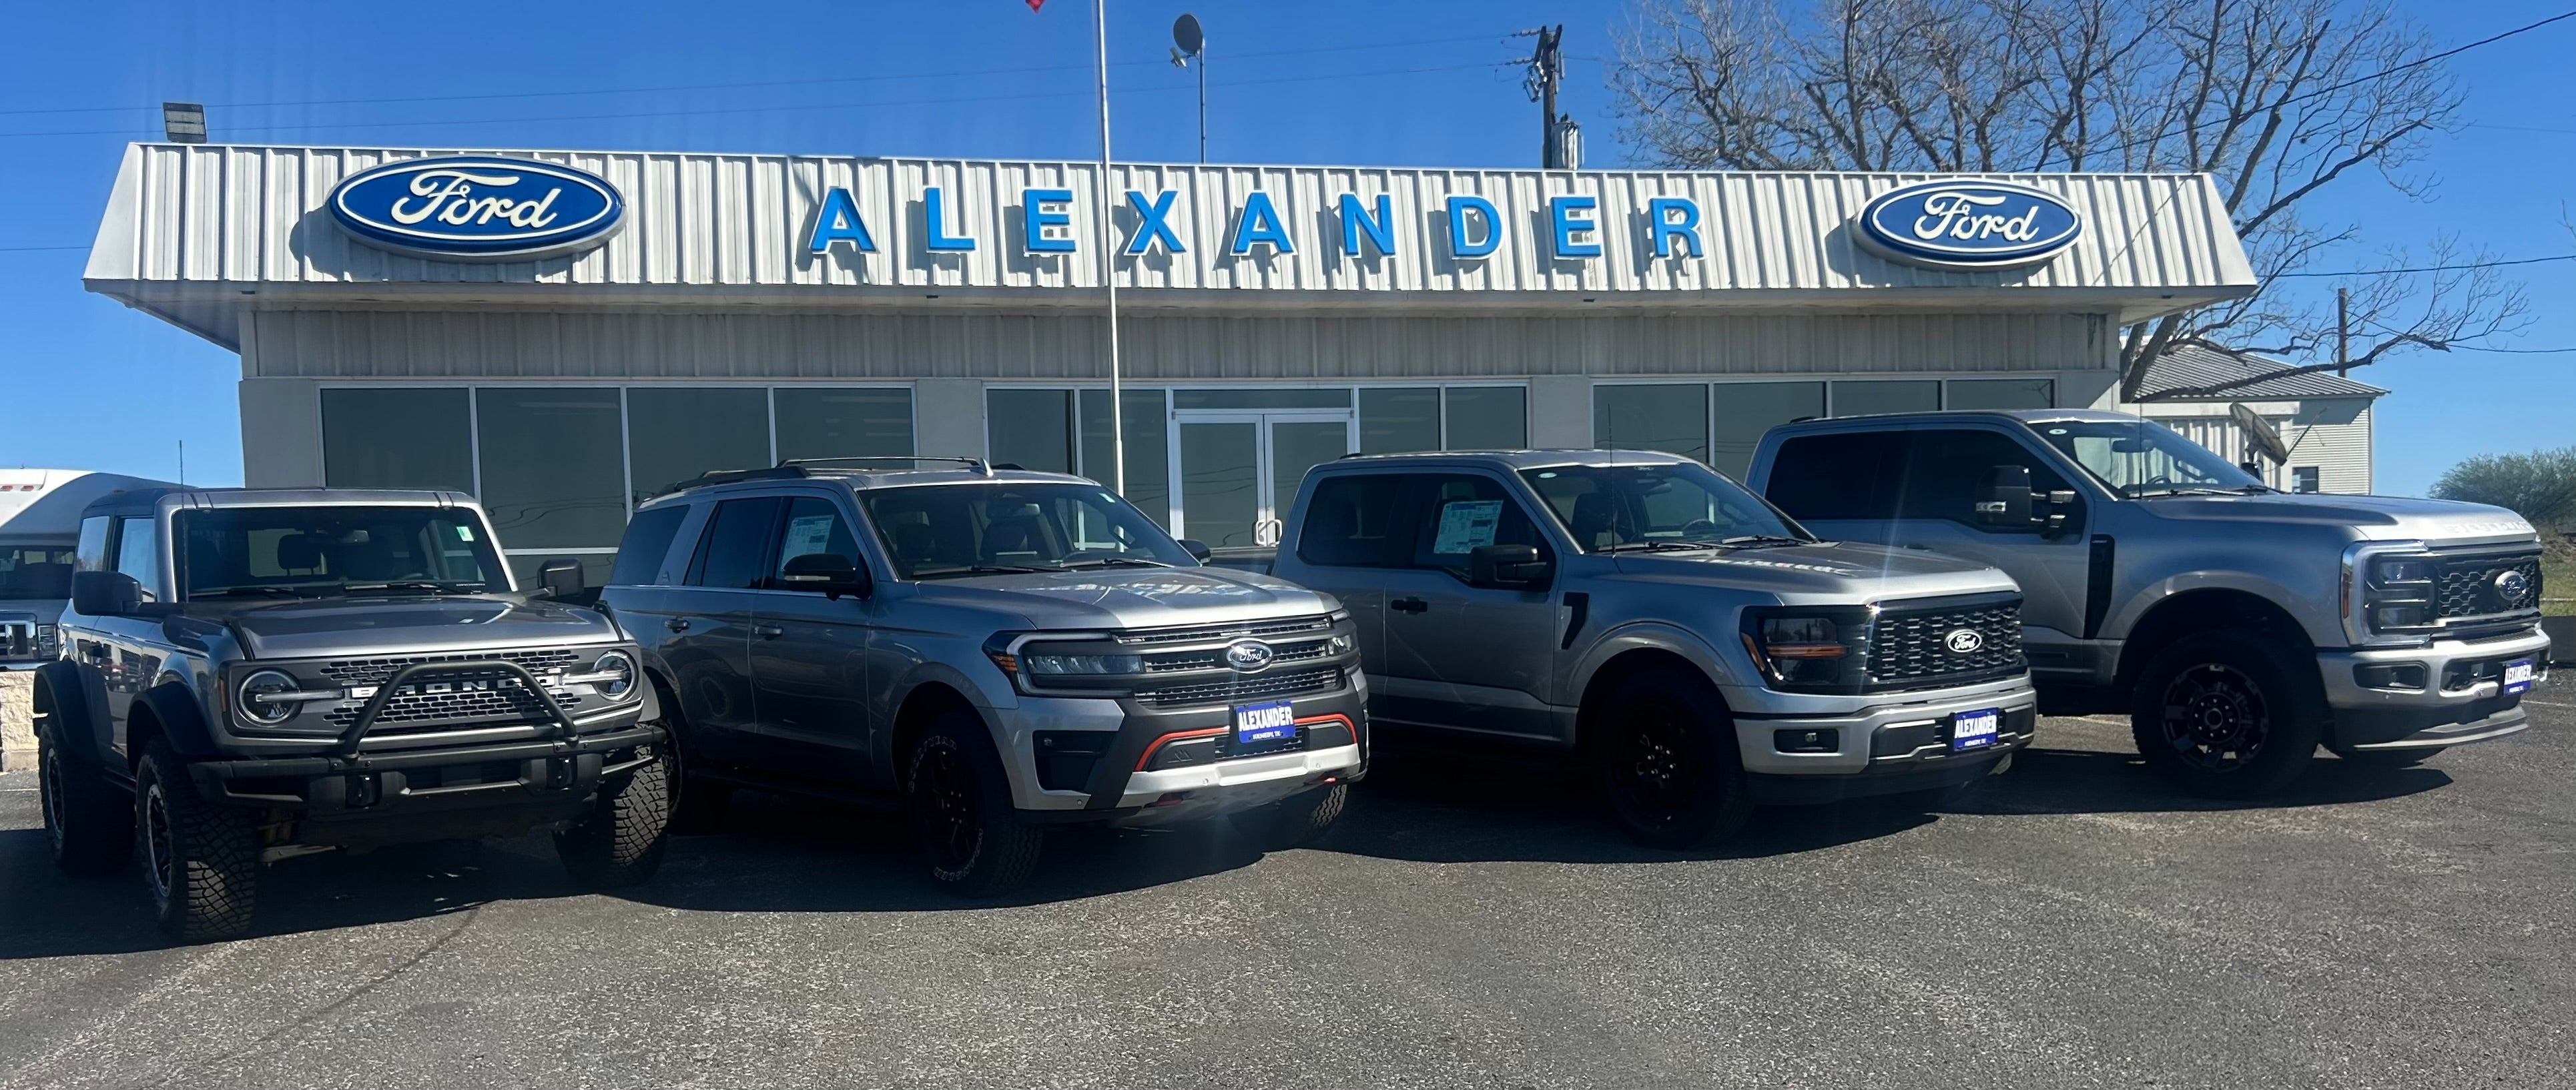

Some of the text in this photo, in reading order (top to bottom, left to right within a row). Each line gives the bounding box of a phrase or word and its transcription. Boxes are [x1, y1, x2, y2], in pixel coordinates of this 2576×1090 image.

[391, 171, 562, 228] Ford
[809, 186, 1705, 259] ALEXANDER
[1913, 192, 2039, 241] Ford
[1239, 648, 1263, 662] Ford
[1955, 634, 1976, 650] Ford
[1239, 706, 1293, 732] ALEXANDER
[1955, 715, 1997, 738] ALEXANDER
